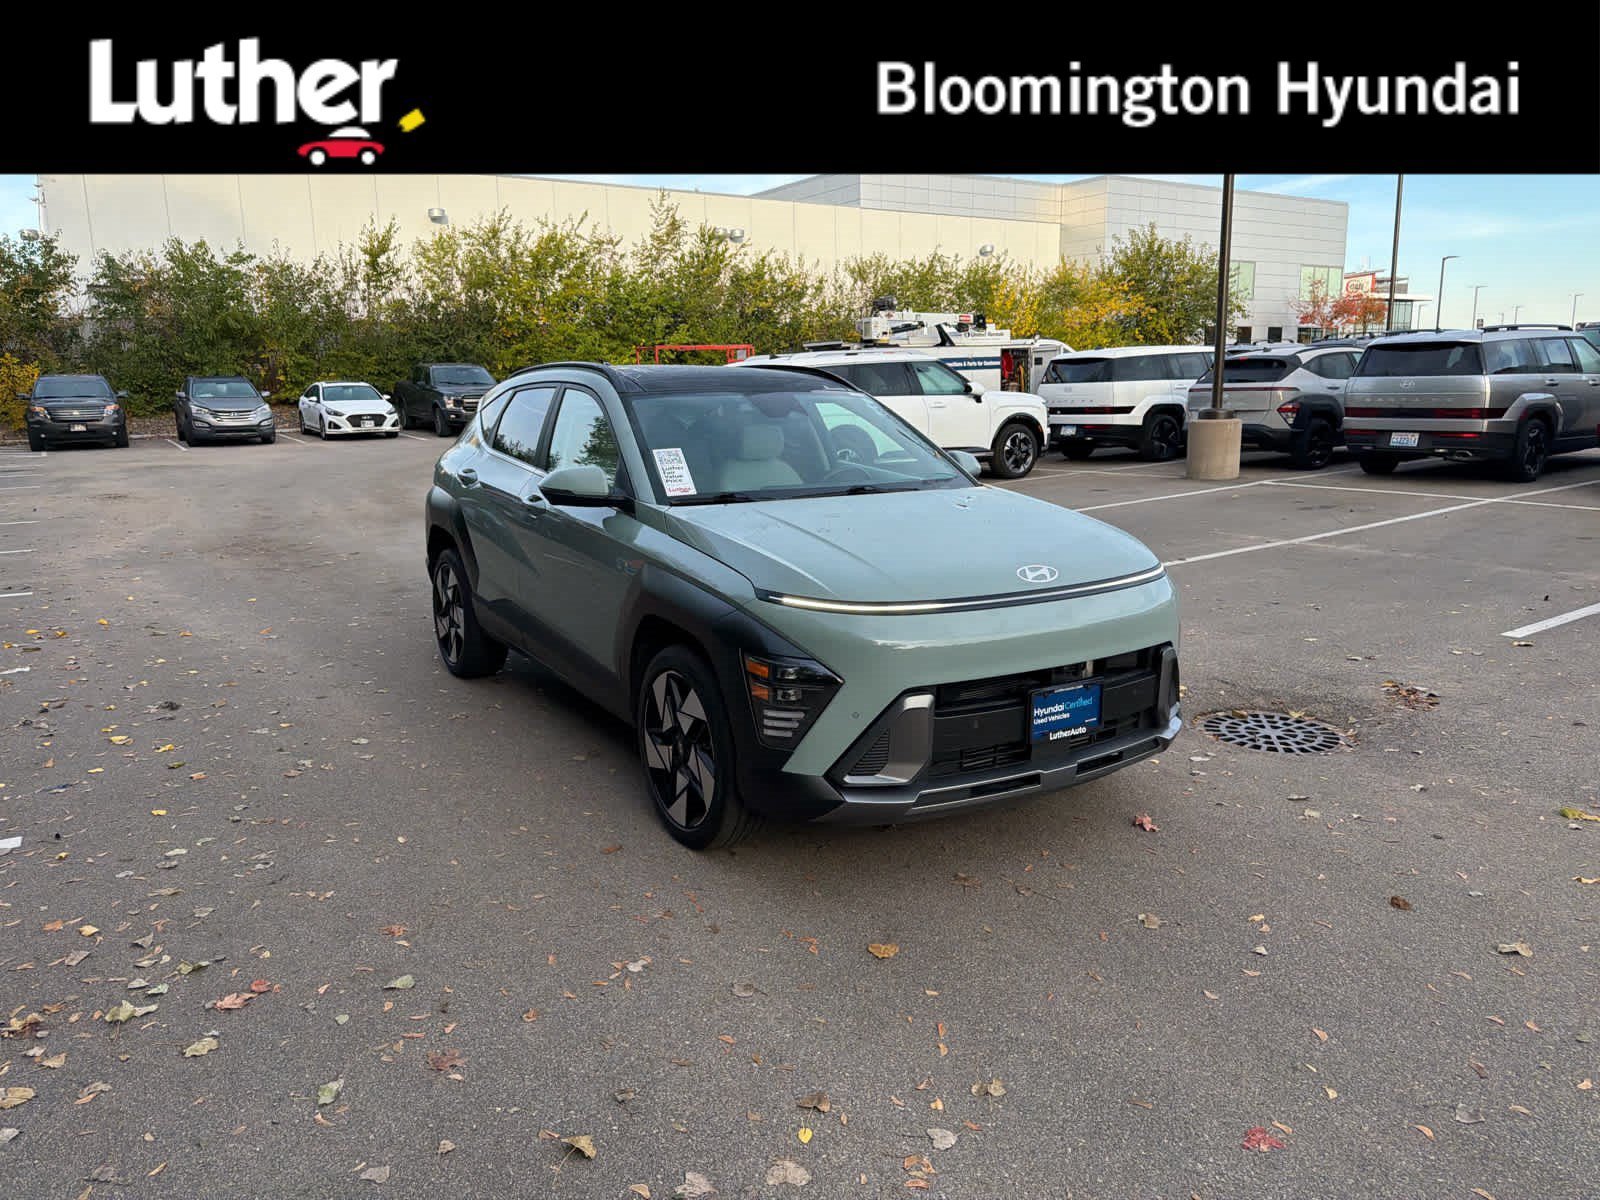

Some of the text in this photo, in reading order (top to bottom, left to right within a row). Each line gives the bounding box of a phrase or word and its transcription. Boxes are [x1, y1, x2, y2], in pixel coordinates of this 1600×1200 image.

[1033, 697, 1093, 717] Hyundai Certified
[1033, 712, 1071, 725] Used Vehicles
[1049, 726, 1087, 741] LutherAuto
